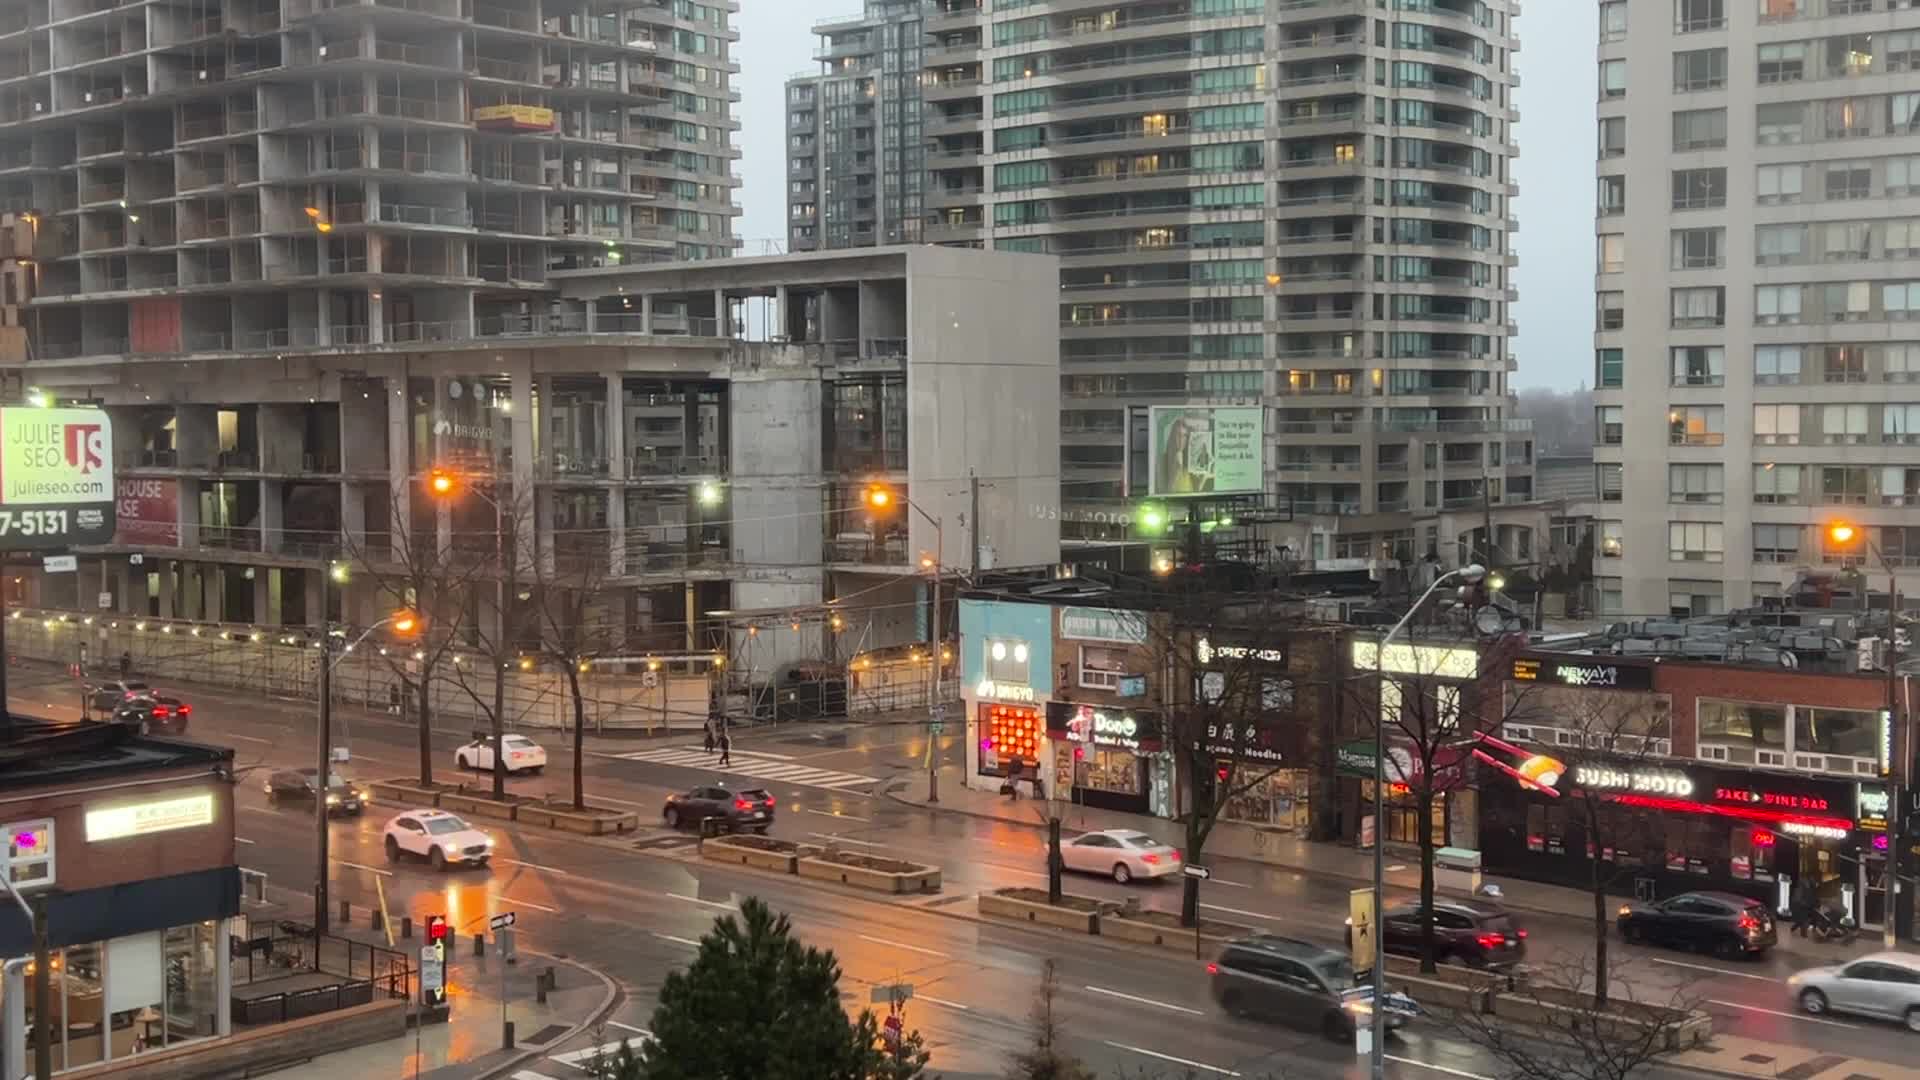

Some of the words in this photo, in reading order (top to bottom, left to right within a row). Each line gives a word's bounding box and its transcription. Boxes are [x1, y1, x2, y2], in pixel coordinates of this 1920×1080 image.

[13, 424, 60, 444] JULIE
[24, 448, 61, 467] SEO
[12, 482, 103, 497] julieseo.com
[1244, 747, 1282, 760] Noodles
[1632, 774, 1693, 796] MOTO
[1715, 788, 1748, 802] SAKE
[1763, 794, 1798, 808] WINE
[1801, 797, 1828, 810] BAR
